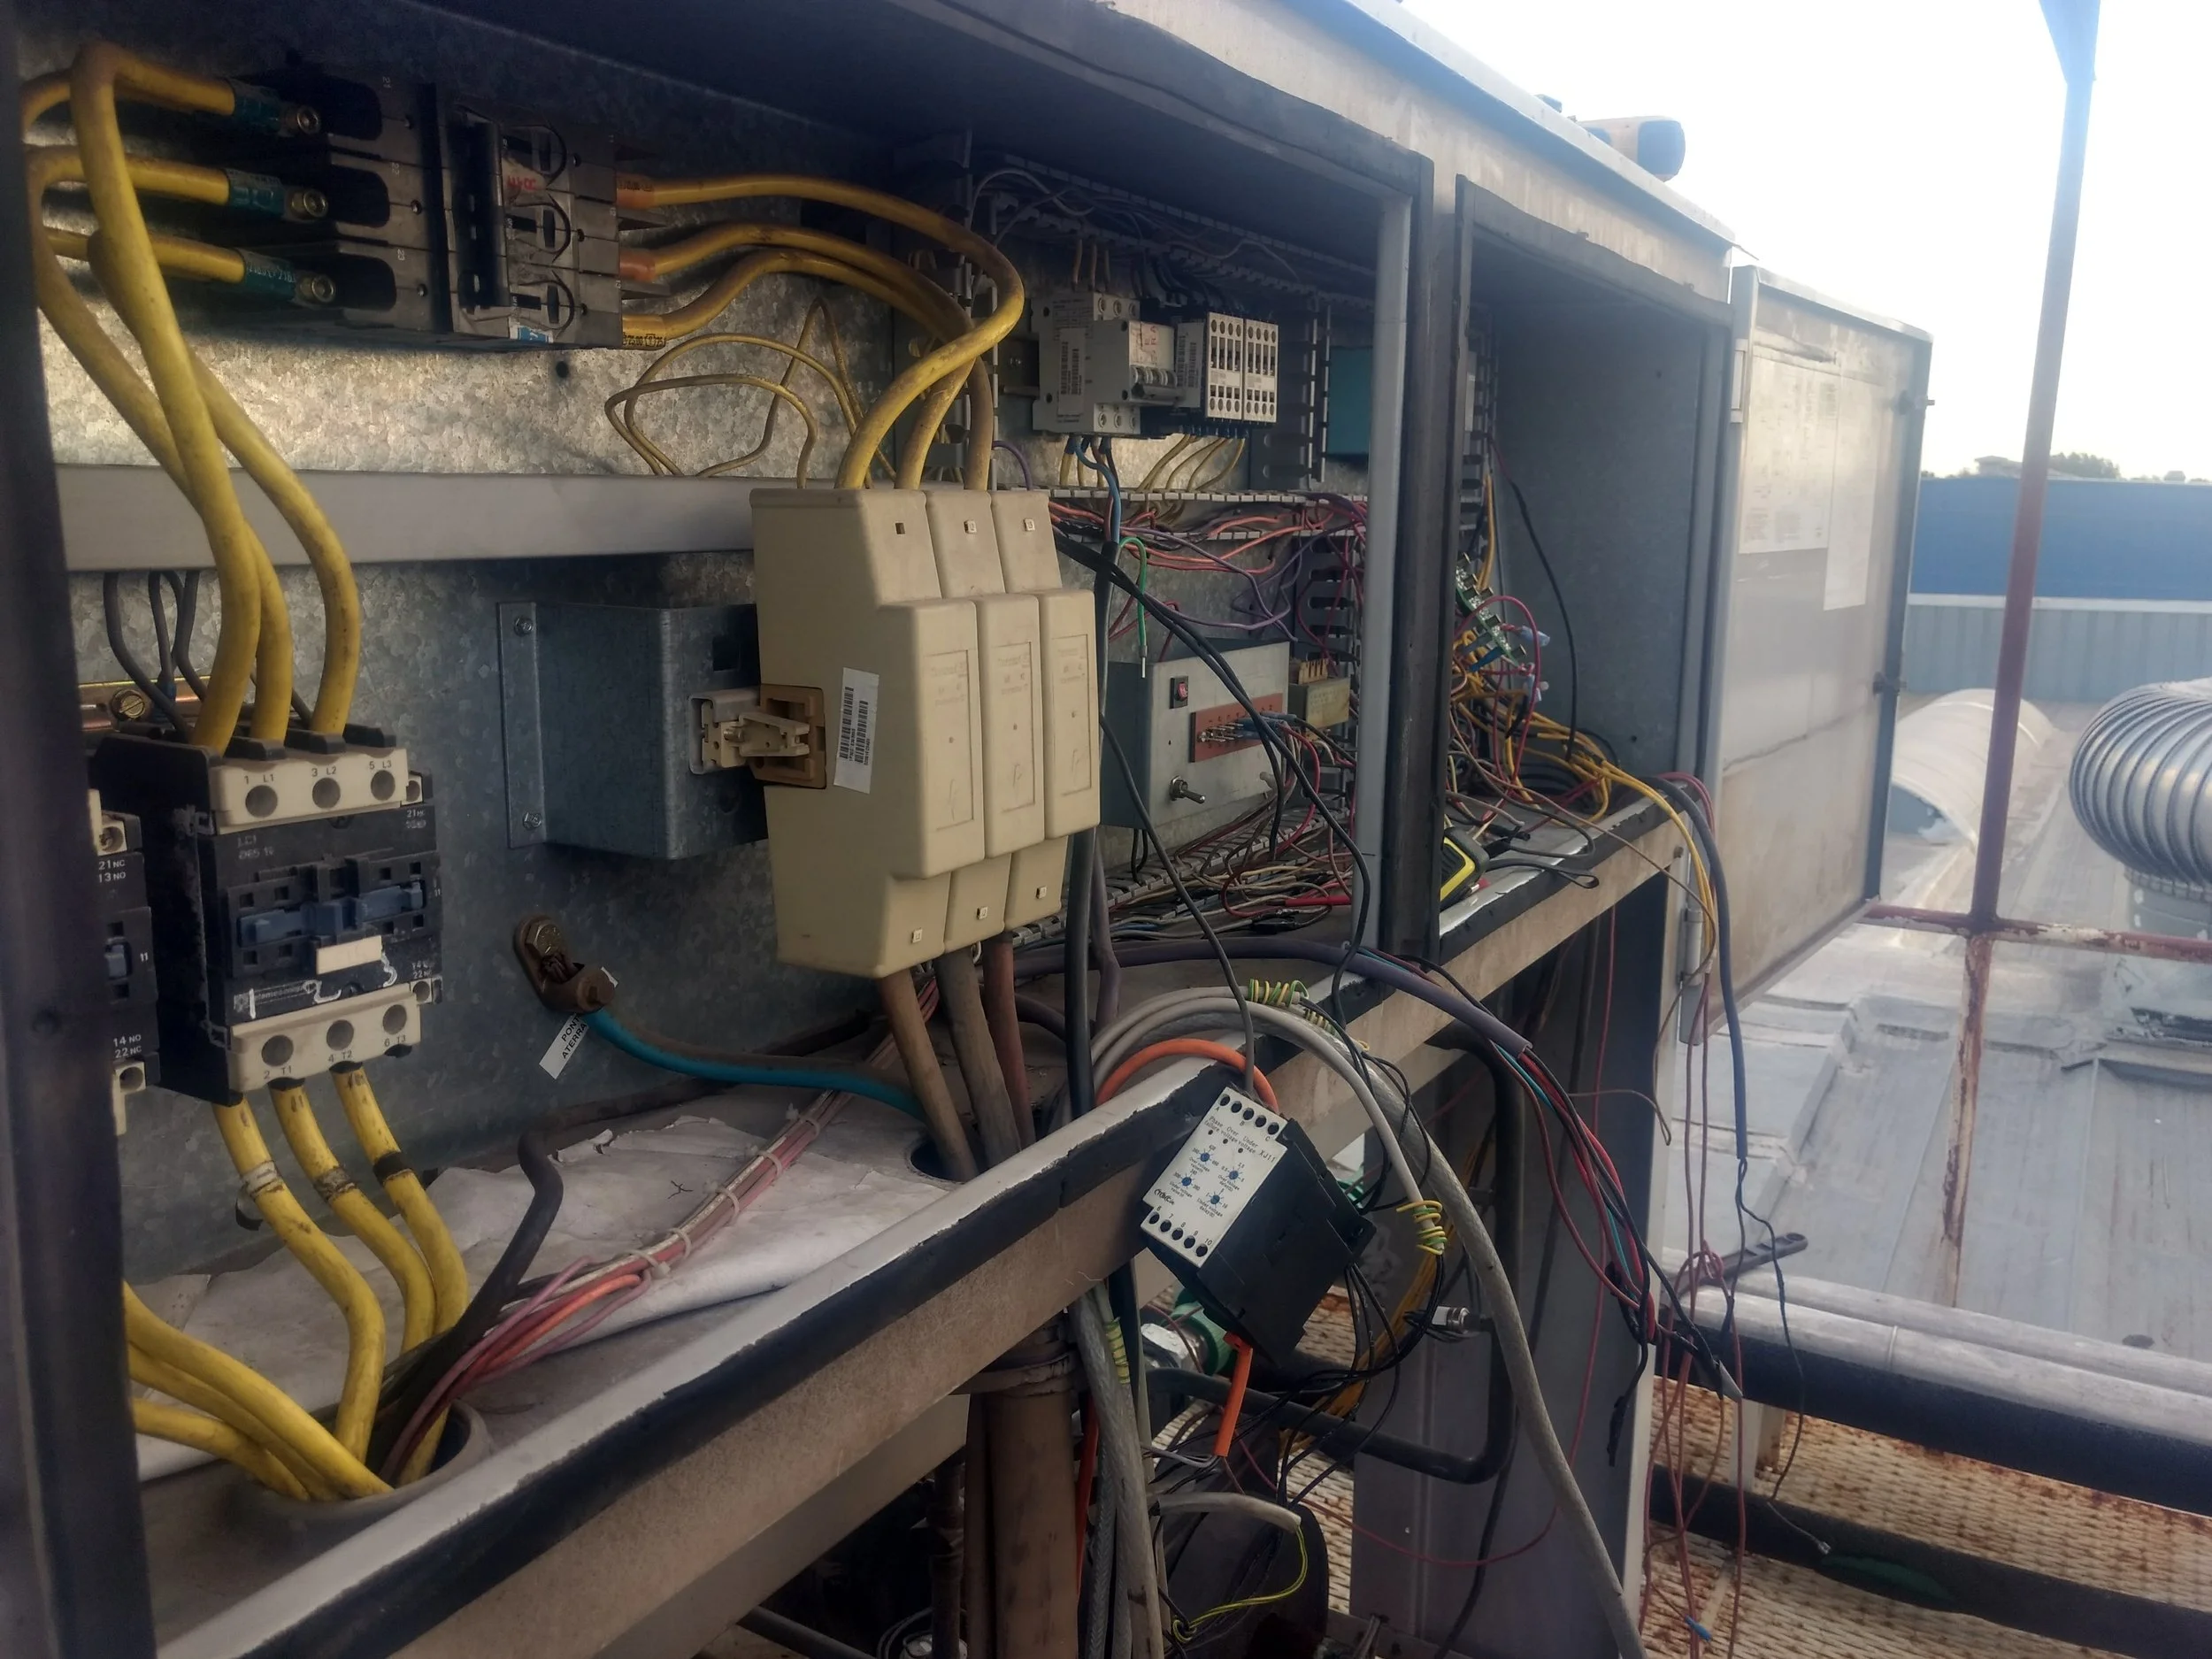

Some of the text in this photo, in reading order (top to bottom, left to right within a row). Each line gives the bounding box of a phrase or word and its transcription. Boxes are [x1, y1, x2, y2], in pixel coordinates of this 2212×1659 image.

[396, 249, 406, 262] 23
[311, 765, 337, 777] 3 L2
[369, 759, 392, 770] 5 L3
[244, 773, 274, 785] 1 L1
[140, 952, 149, 962] 11
[562, 1016, 580, 1042] PONT
[384, 1034, 406, 1047] 6 T3
[328, 1050, 352, 1063] 4 T2
[264, 1066, 292, 1079] 2 T1
[1203, 1120, 1256, 1154] failure voltage voltage
[1209, 1116, 1259, 1148] Phase Over Under
[1259, 1149, 1276, 1163] XJ11
